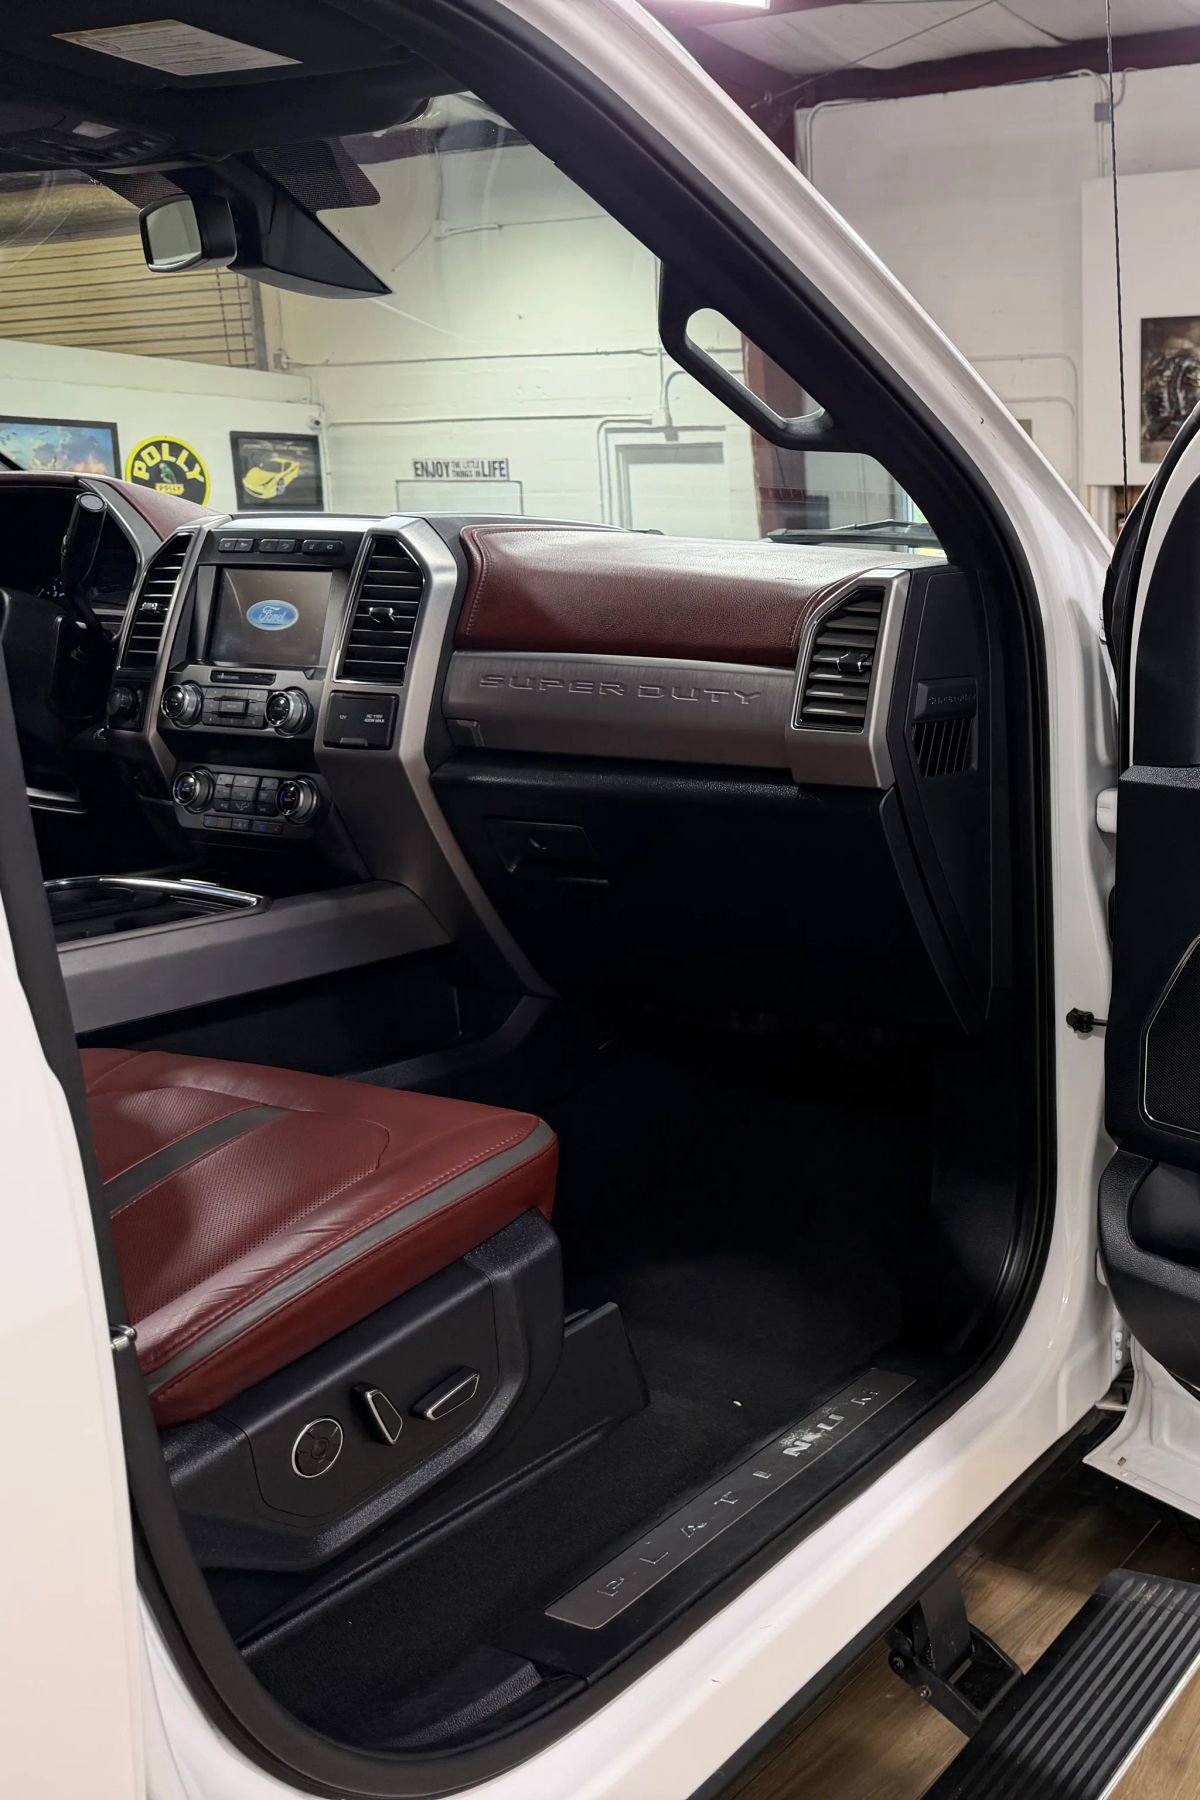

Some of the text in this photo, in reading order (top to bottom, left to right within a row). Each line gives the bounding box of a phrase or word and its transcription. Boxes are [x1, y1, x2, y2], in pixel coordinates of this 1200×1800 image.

[133, 443, 204, 483] POLLY
[413, 461, 450, 478] ENJOY
[481, 460, 506, 478] LIFE
[259, 605, 288, 622] Ford
[479, 674, 761, 705] SUPER DUTY
[597, 1390, 880, 1598] PLATINUM
